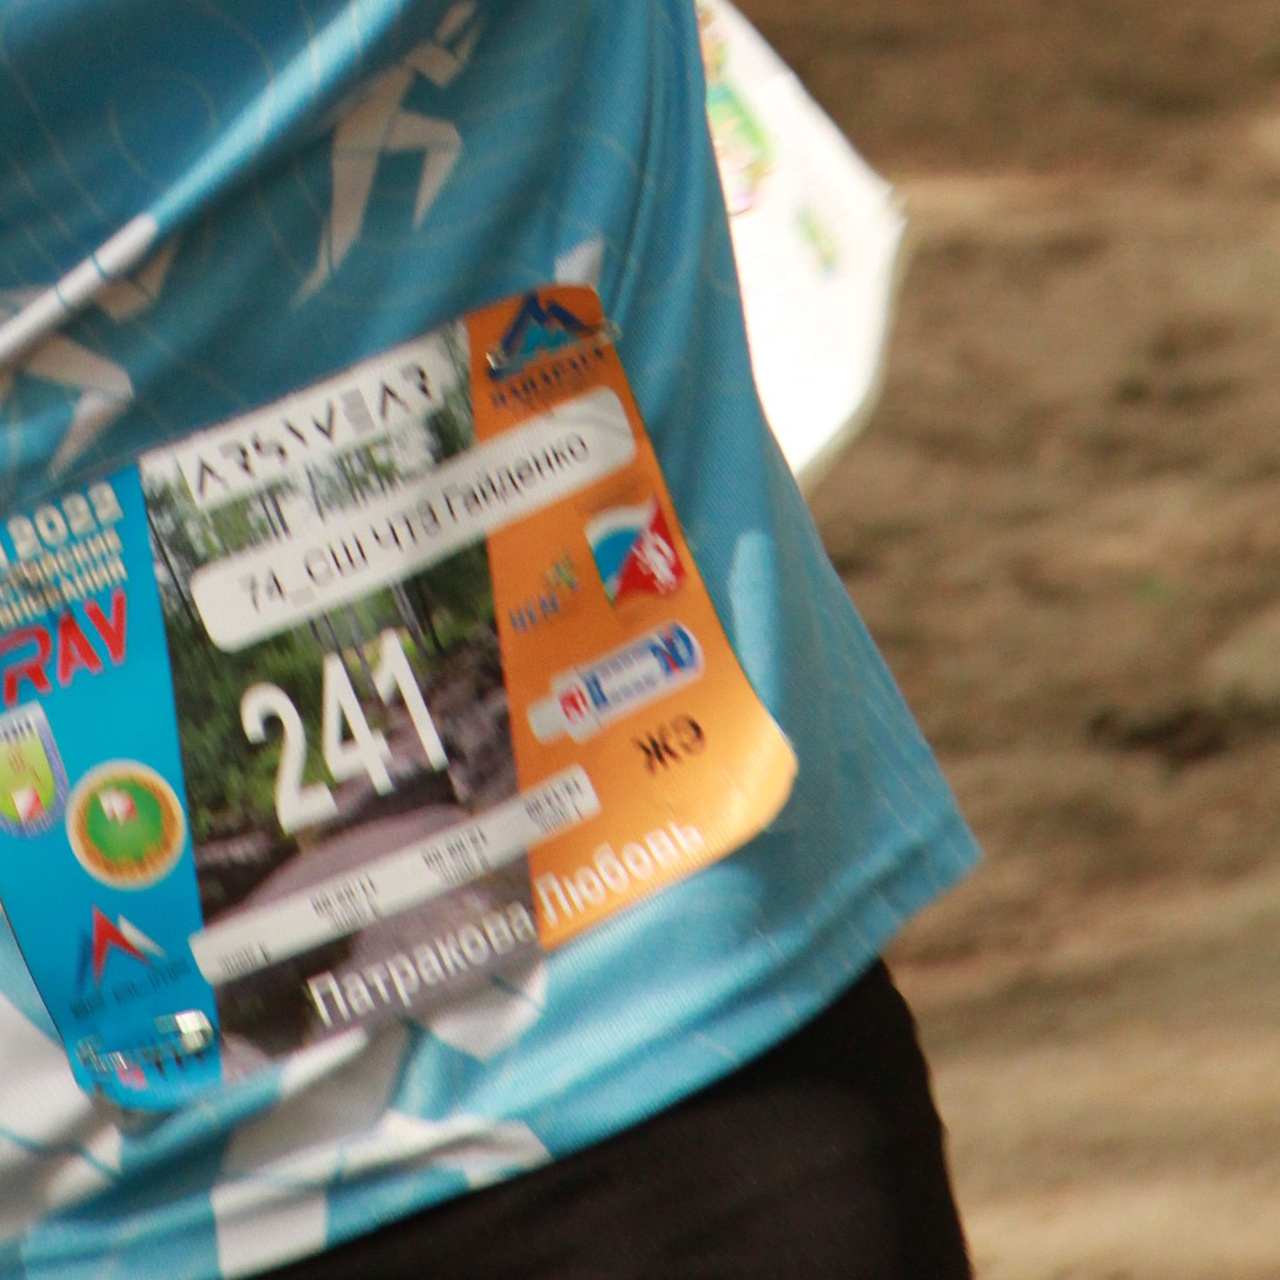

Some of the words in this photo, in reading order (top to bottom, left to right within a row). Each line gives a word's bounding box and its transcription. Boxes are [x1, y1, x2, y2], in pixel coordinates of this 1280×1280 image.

[442, 431, 589, 524] Гайденко
[239, 627, 450, 838] 241
[306, 900, 539, 1028] Патракова
[533, 820, 707, 930] Любовь
